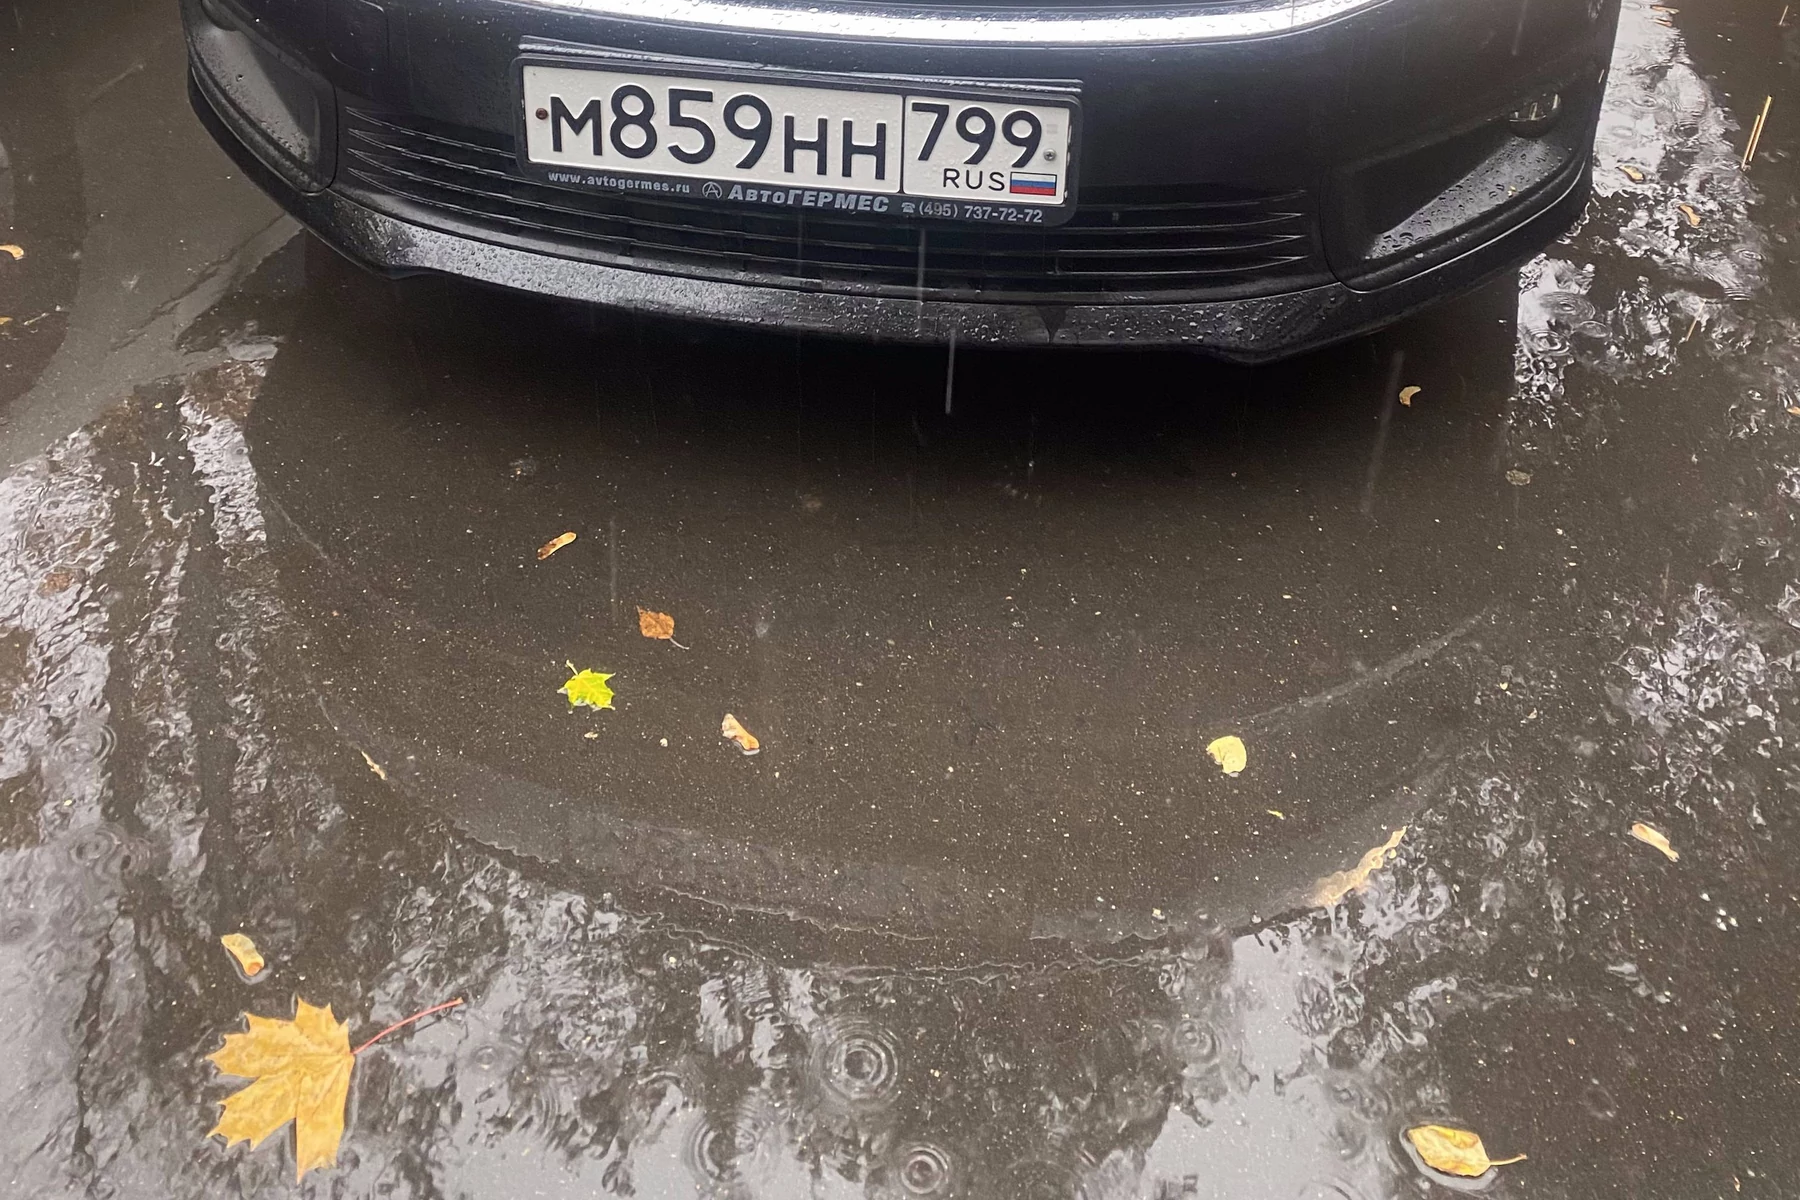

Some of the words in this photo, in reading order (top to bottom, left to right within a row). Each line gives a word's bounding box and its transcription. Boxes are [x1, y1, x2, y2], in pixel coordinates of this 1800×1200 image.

[911, 102, 1042, 168] 799
[548, 170, 690, 194] www.avtogermes.ru
[943, 167, 1006, 191] RUS
[918, 200, 959, 218] (495)
[964, 205, 1043, 224] 737-72-72
